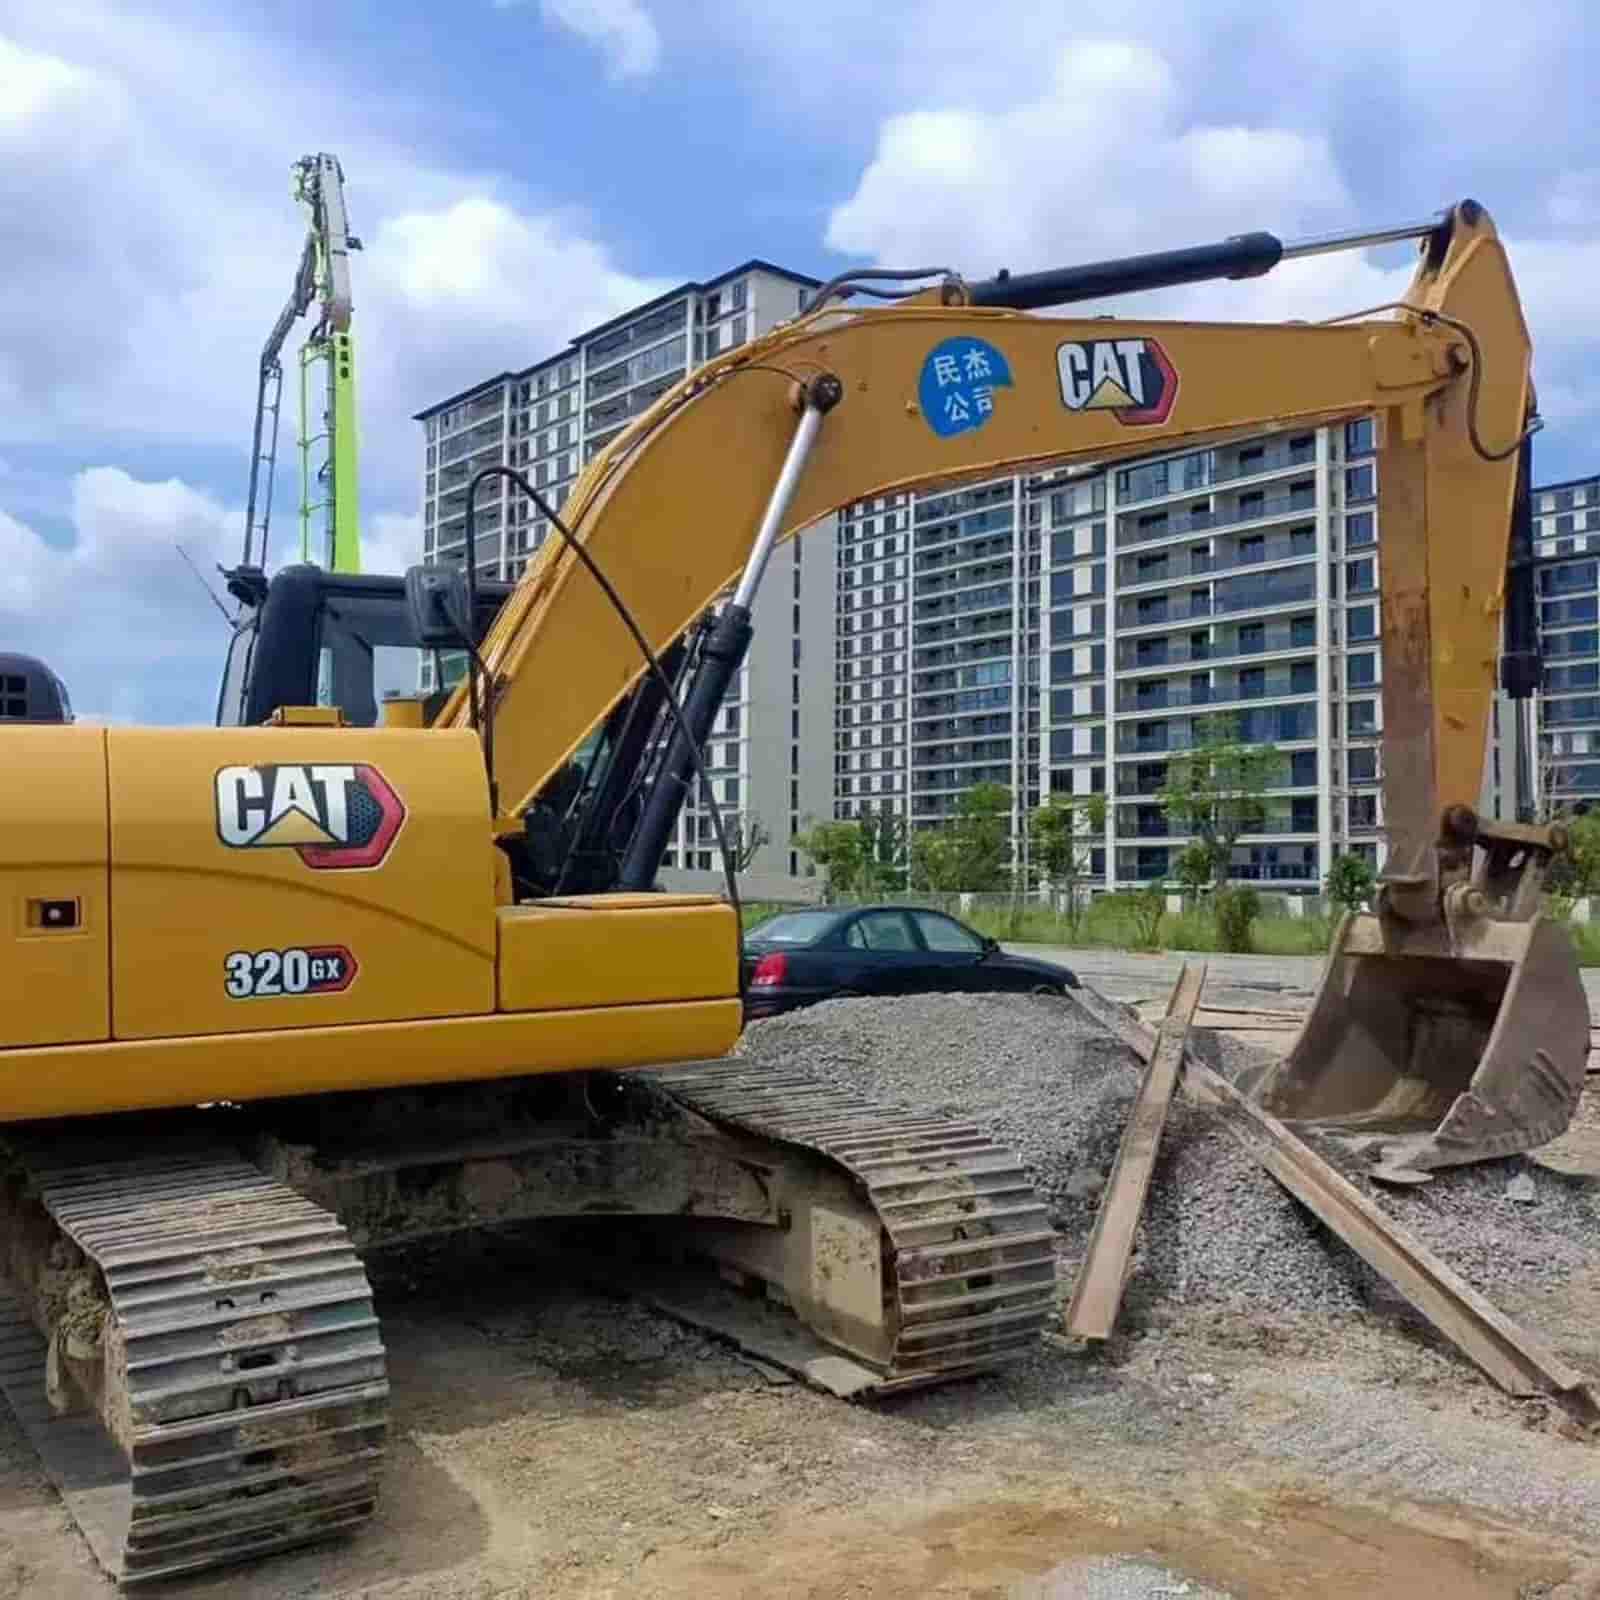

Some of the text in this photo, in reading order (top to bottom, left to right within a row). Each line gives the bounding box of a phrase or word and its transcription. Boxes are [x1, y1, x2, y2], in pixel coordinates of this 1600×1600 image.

[932, 347, 993, 387] 民杰
[1056, 339, 1145, 410] CAT
[943, 385, 994, 423] 公司
[216, 765, 356, 846] CAT
